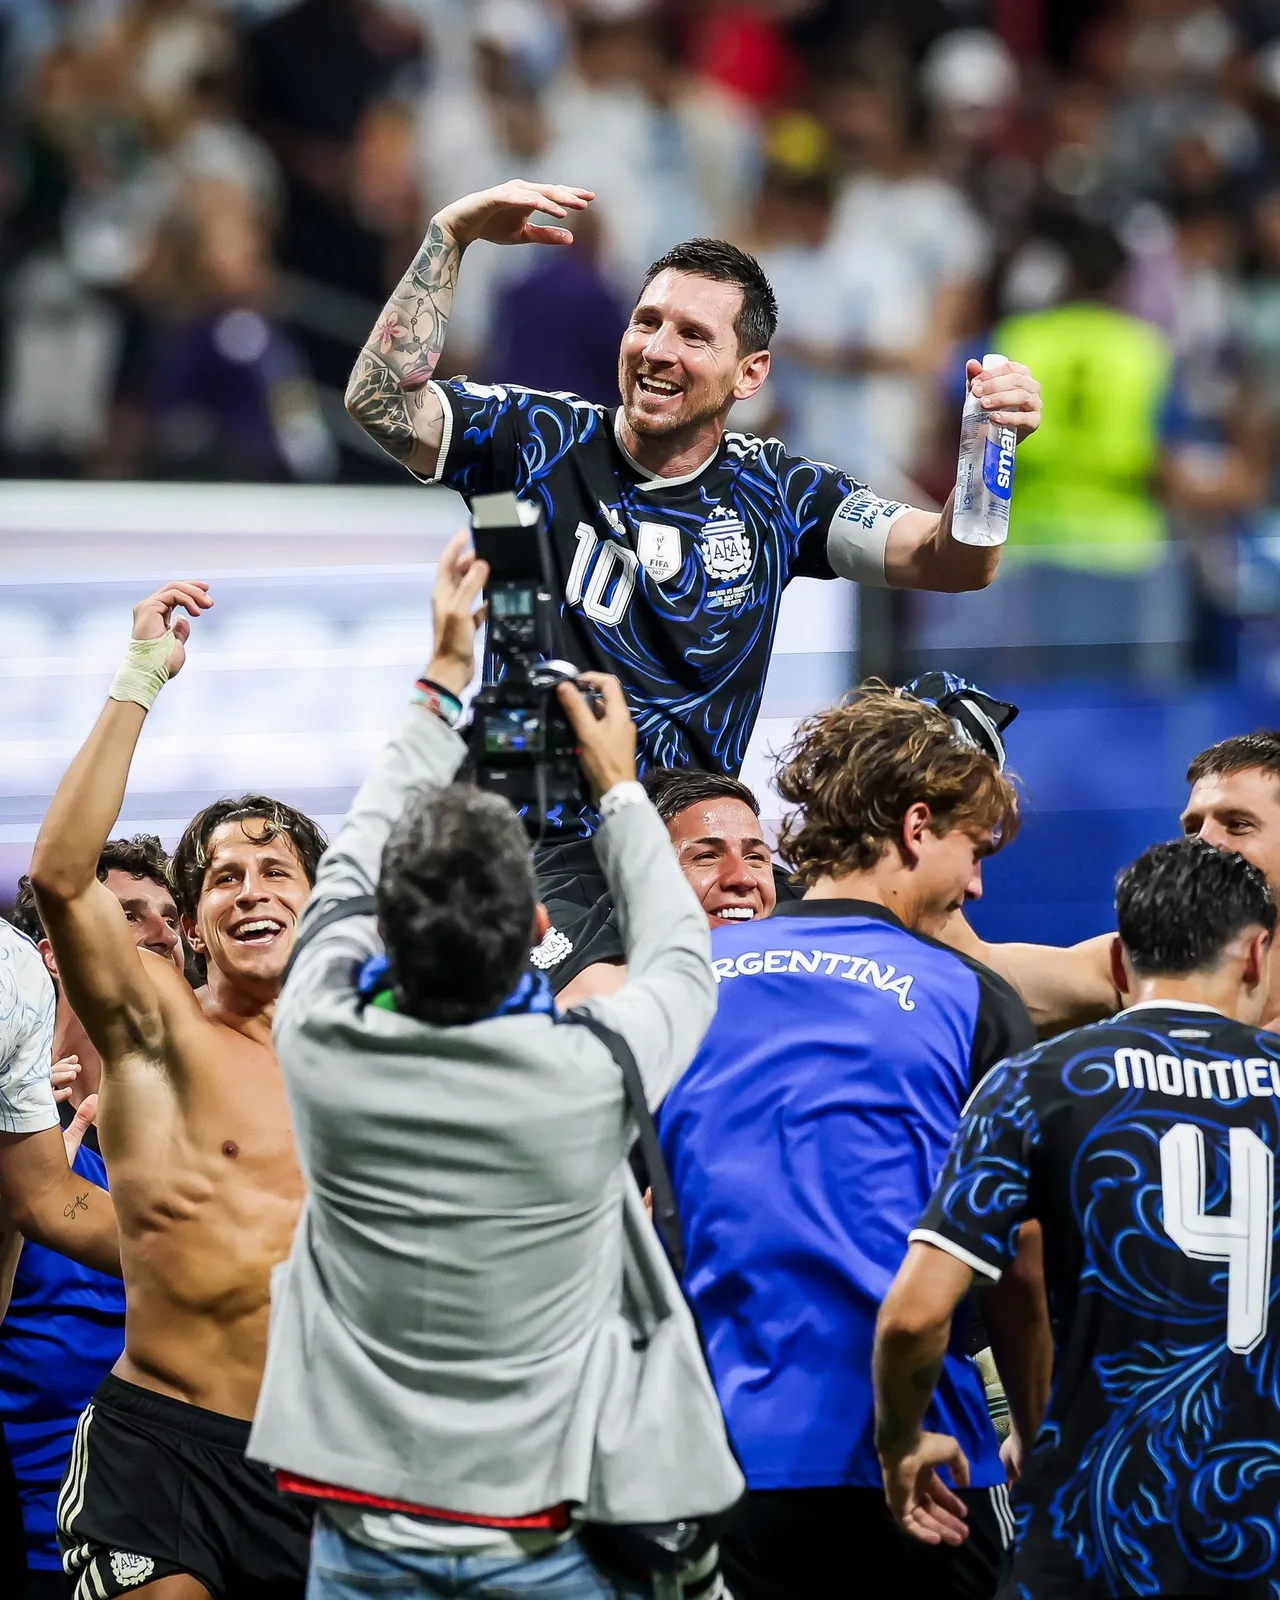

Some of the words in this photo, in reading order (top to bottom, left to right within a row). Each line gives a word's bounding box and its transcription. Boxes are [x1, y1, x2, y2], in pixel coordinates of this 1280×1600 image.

[997, 428, 1015, 489] smar
[838, 491, 866, 520] FOOTB
[847, 498, 873, 522] UNI
[862, 508, 878, 529] the
[713, 536, 741, 562] AFA
[566, 521, 639, 627] 10
[650, 559, 669, 568] FIFA
[710, 949, 916, 1012] RGENTINA
[1159, 1123, 1275, 1356] 4
[121, 1553, 143, 1570] AFA
